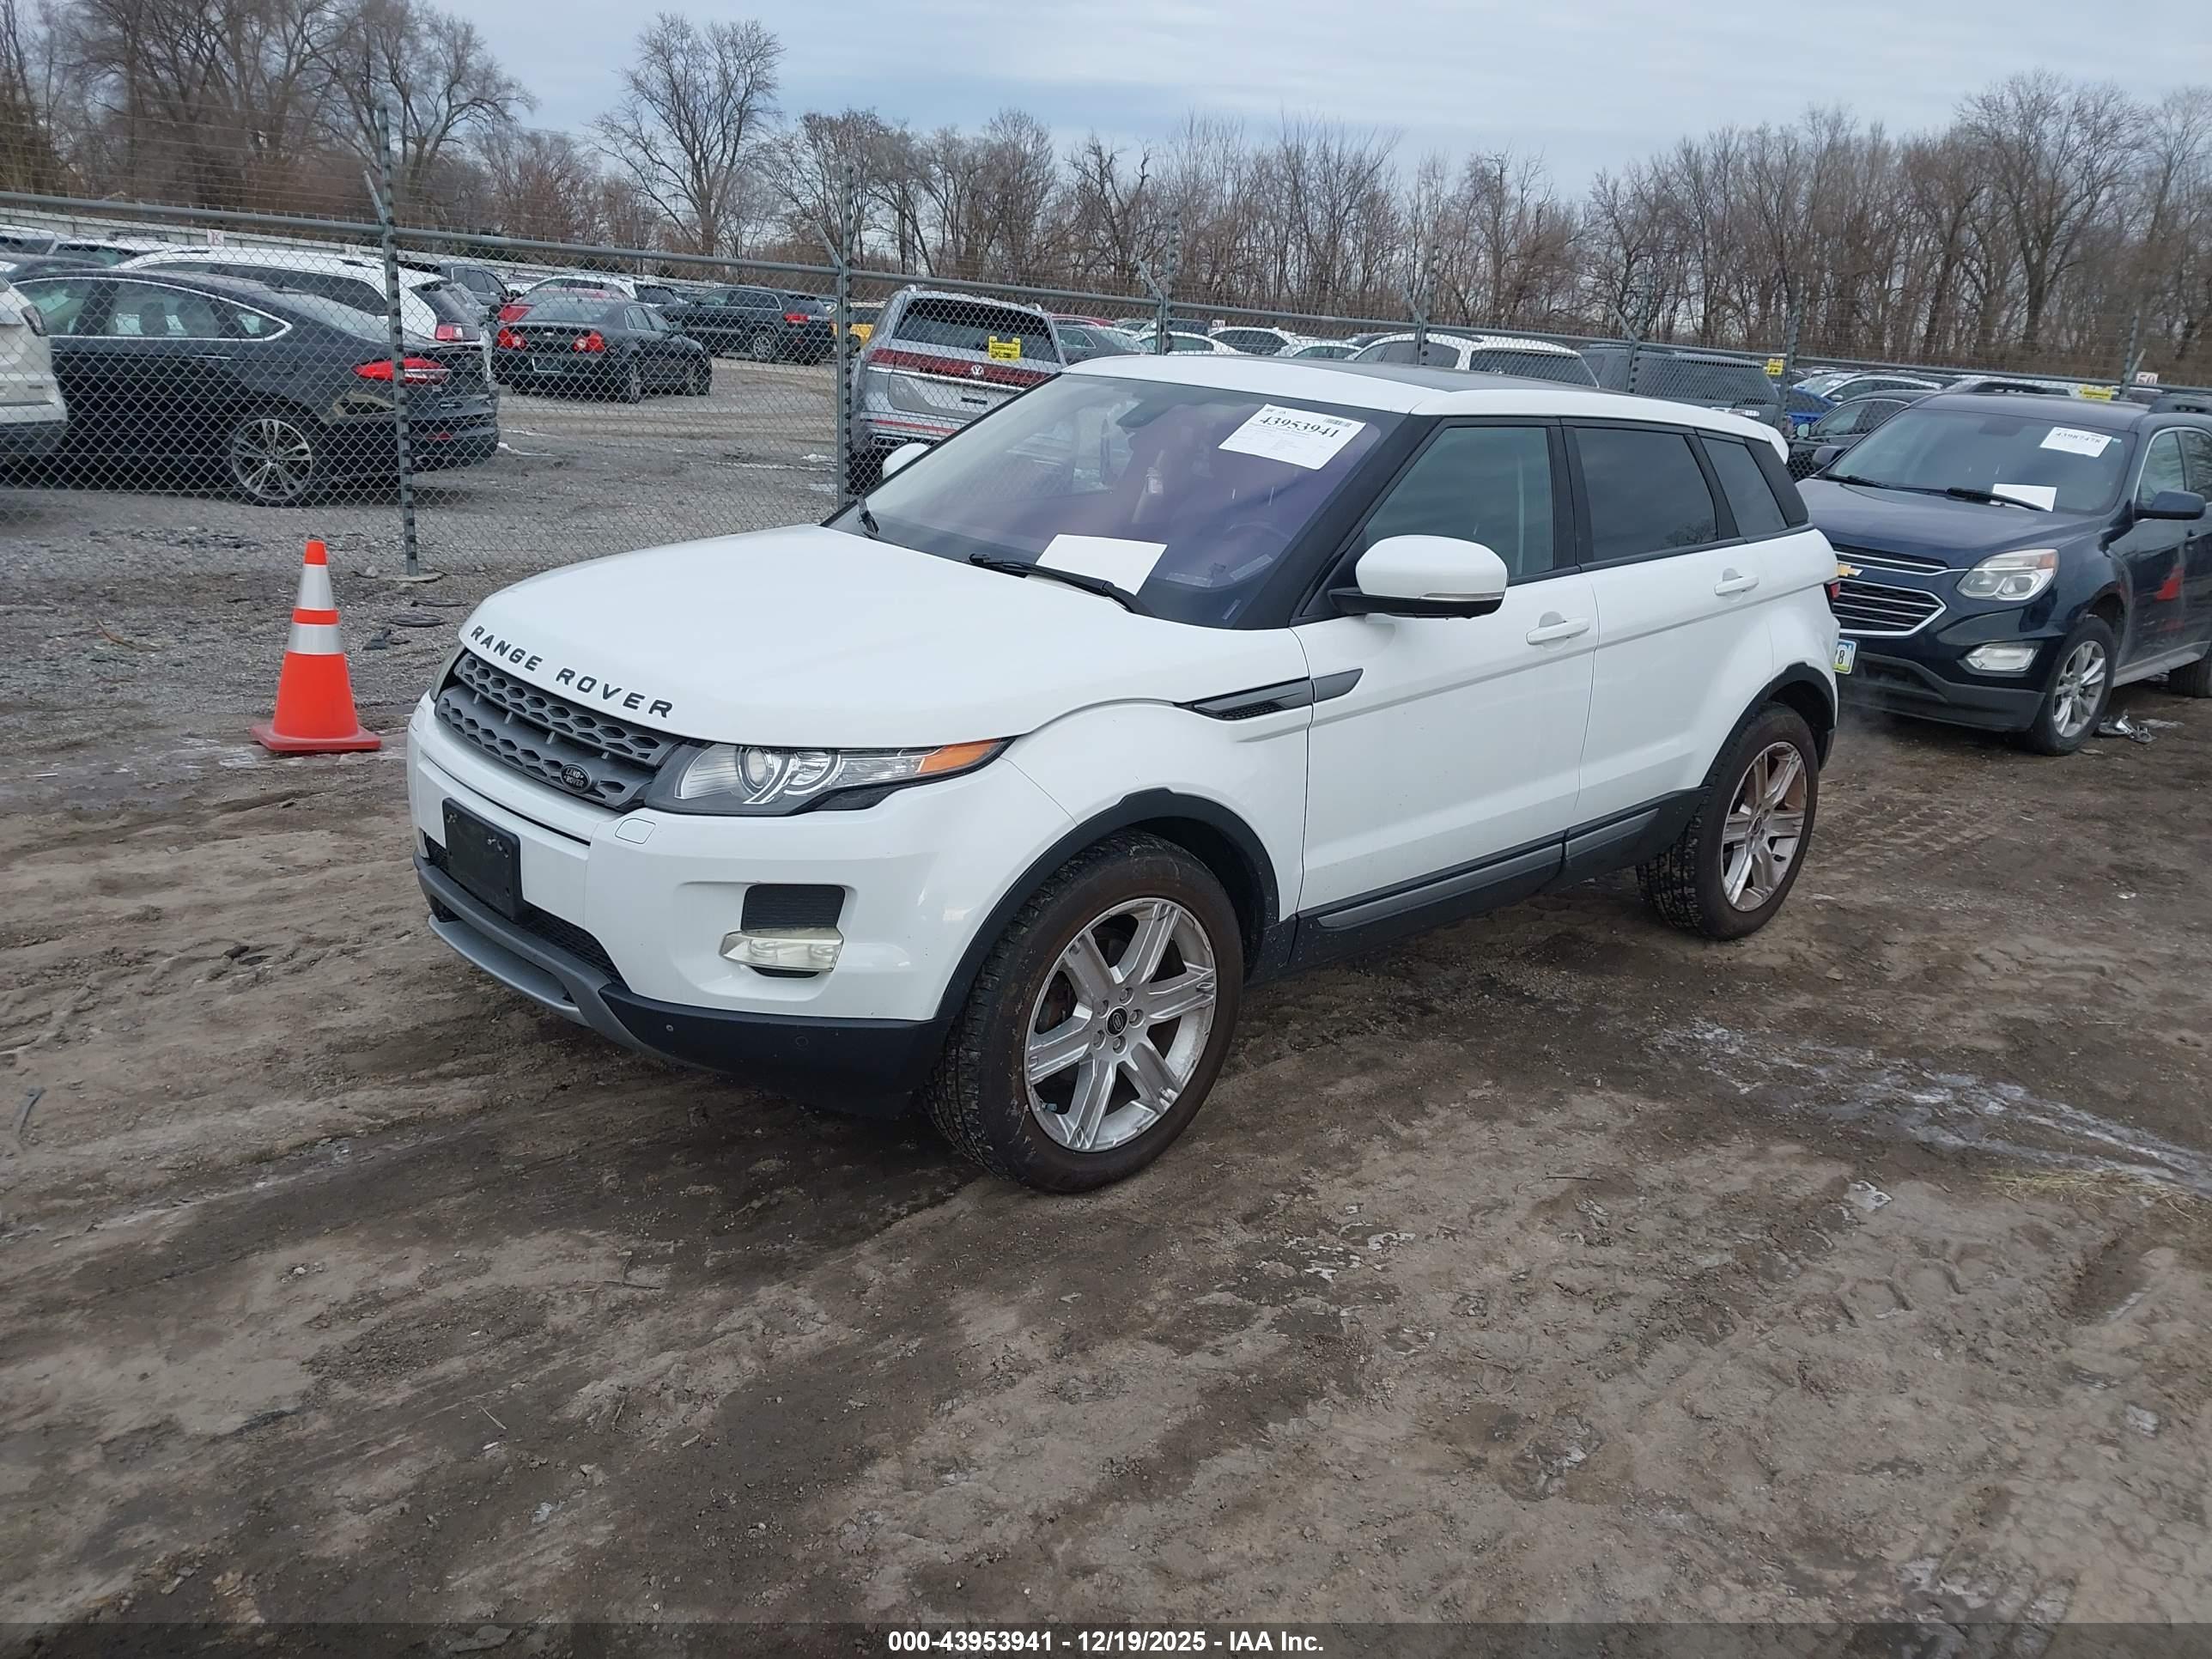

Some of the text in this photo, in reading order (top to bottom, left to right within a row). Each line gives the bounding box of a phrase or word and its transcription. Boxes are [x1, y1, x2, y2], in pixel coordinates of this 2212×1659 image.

[1259, 416, 1340, 438] 43953941
[470, 625, 673, 718] RANGE ROVER
[566, 768, 580, 778] LAND
[566, 775, 584, 787] ROVER
